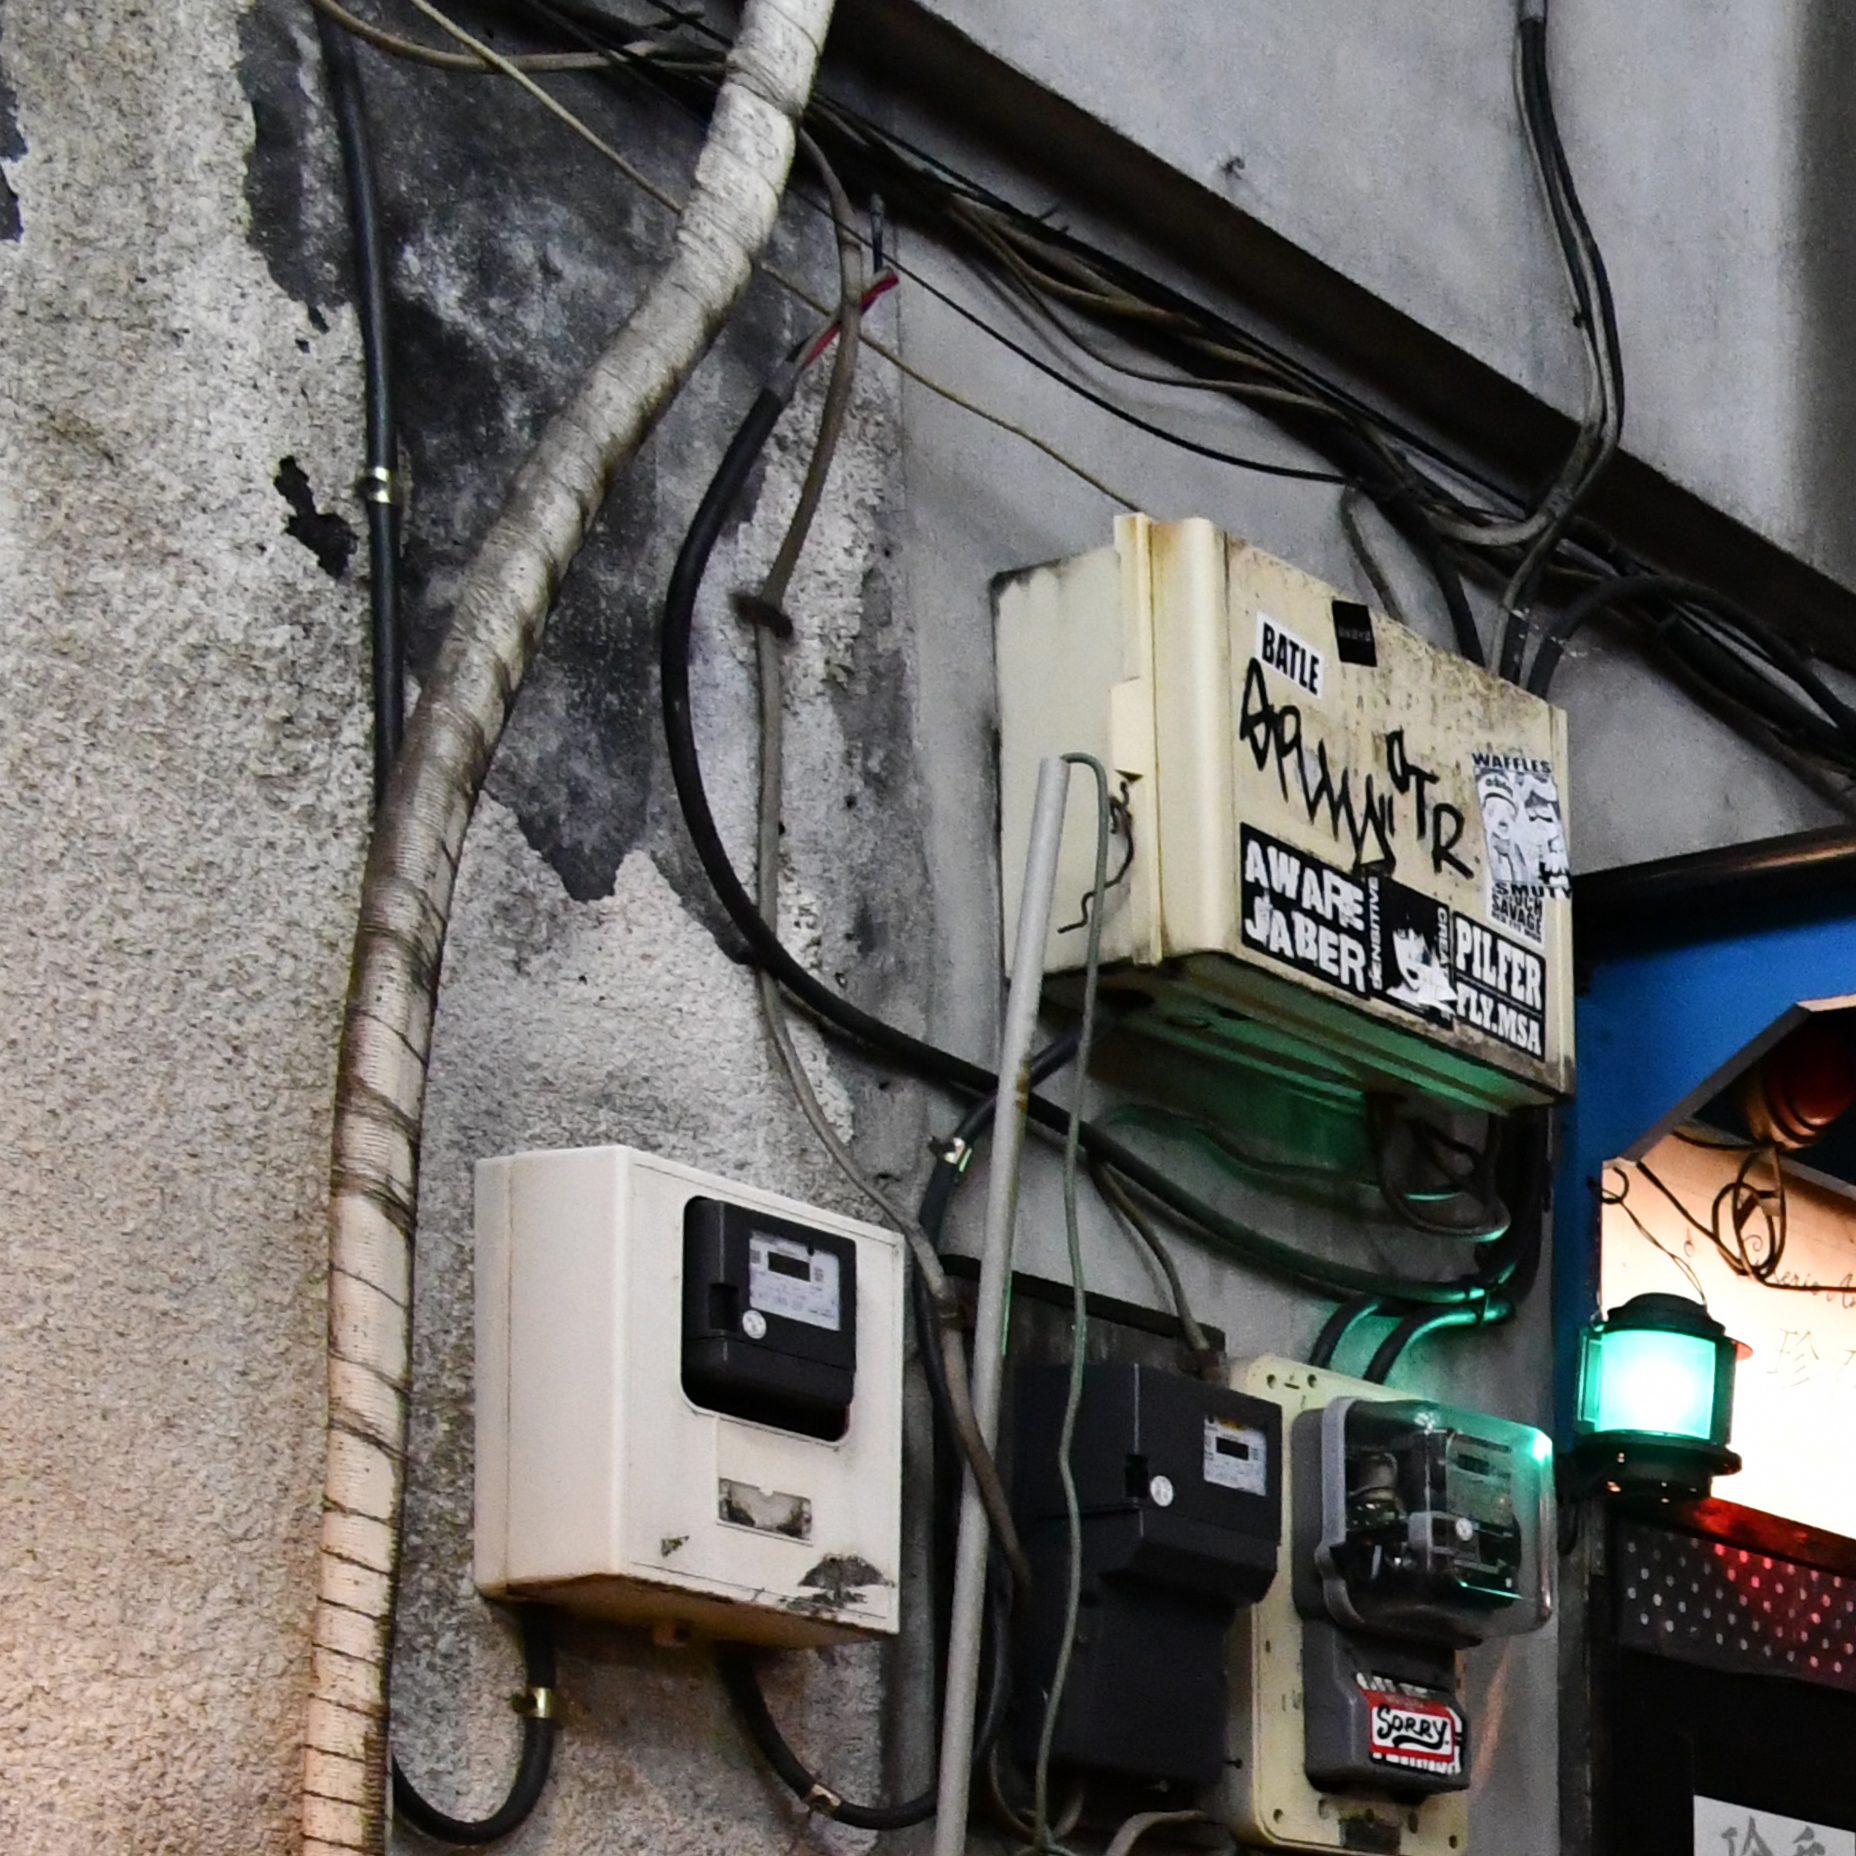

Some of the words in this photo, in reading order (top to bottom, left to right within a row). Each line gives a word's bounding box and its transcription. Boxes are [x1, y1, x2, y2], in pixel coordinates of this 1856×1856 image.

[1262, 622, 1319, 696] BATLE
[1472, 753, 1552, 774] WAFFLES
[1491, 896, 1543, 936] SAVAGE
[1499, 882, 1574, 900] SMUTY
[1244, 895, 1366, 993] JABER
[1455, 917, 1542, 1012] PILFER
